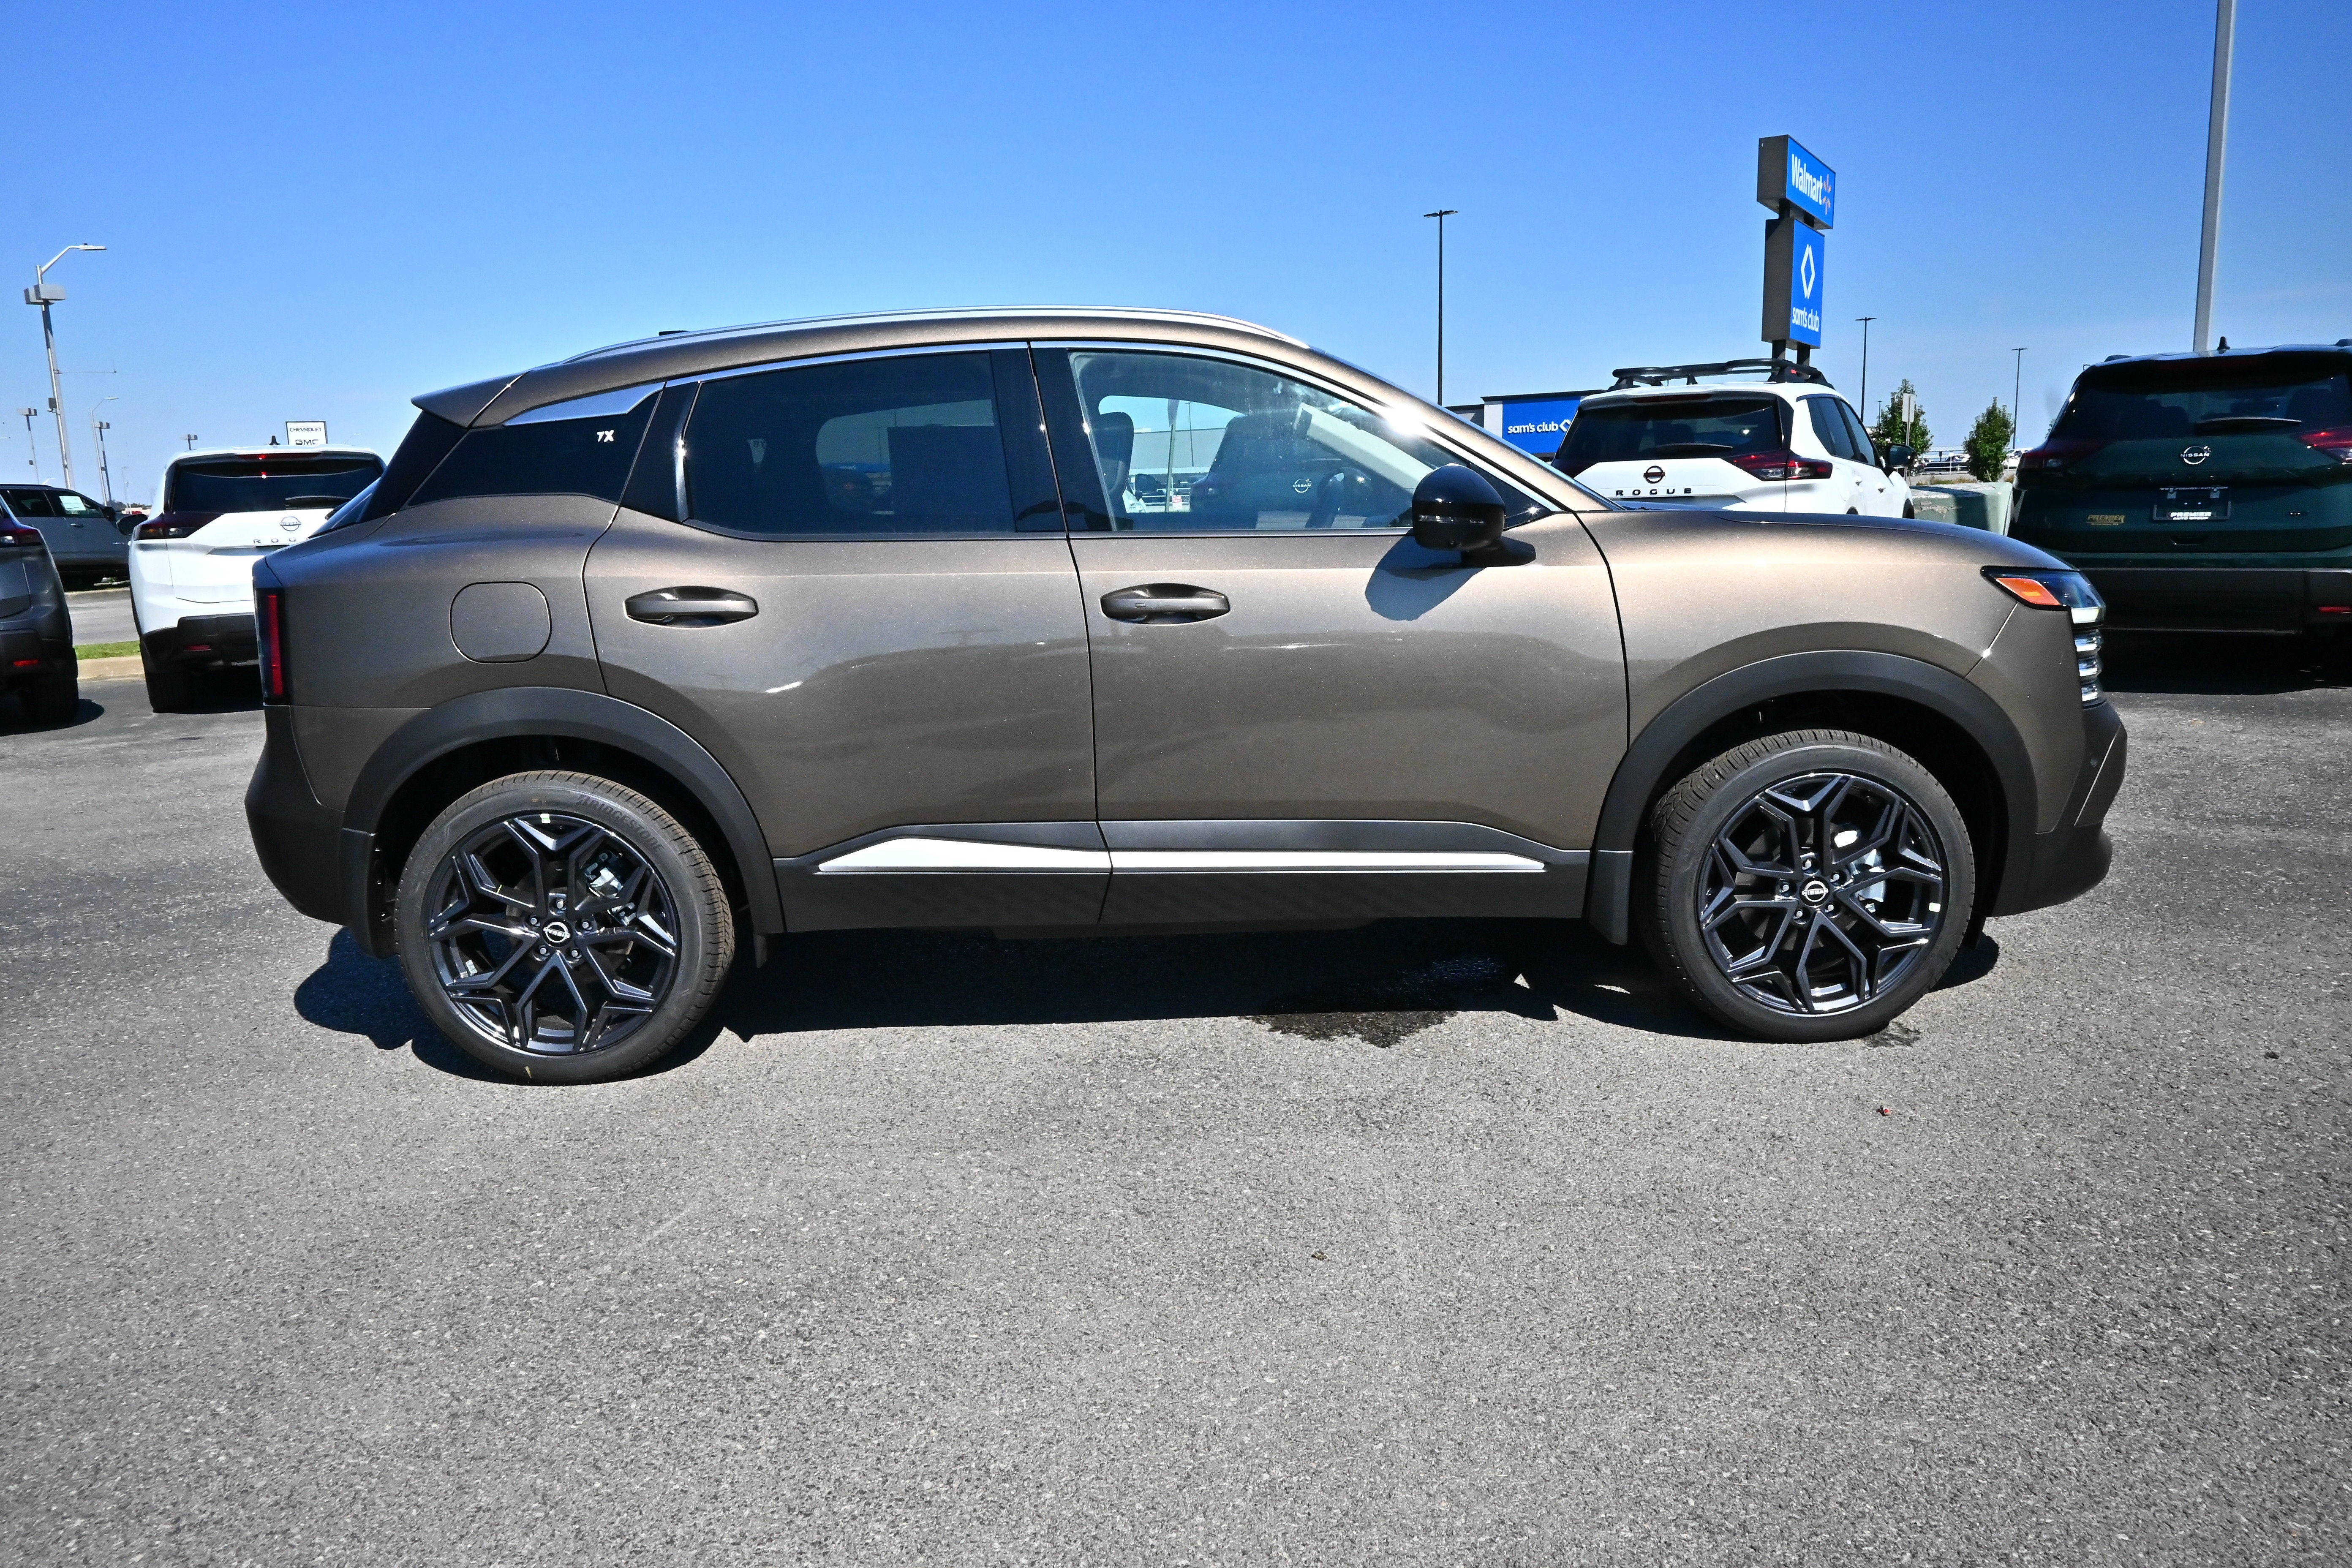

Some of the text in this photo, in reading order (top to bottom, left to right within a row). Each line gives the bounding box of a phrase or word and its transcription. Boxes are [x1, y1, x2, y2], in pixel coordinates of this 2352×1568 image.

[1791, 153, 1822, 205] Walmart
[1792, 307, 1819, 332] sam's club
[1508, 421, 1559, 433] sam's club
[1616, 488, 1692, 496] ROGUE
